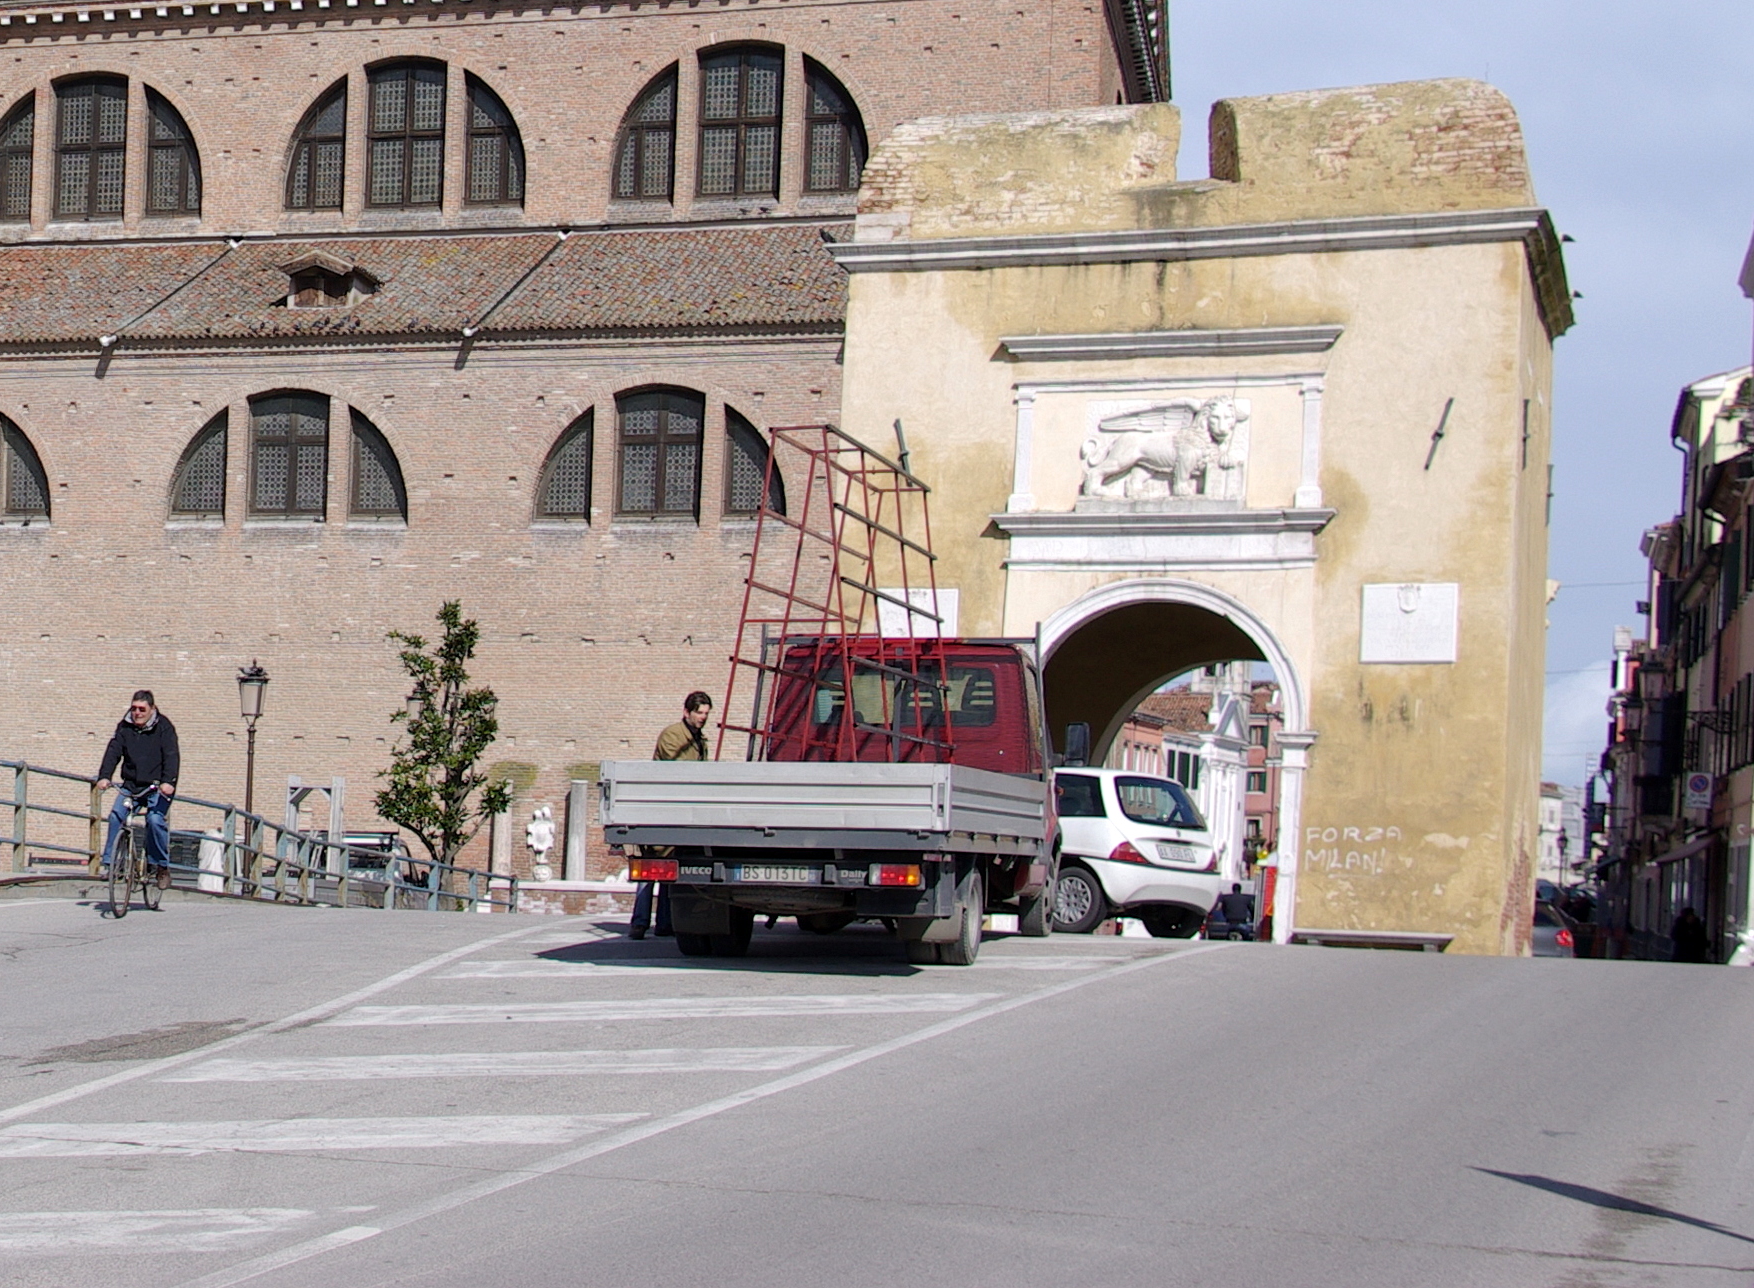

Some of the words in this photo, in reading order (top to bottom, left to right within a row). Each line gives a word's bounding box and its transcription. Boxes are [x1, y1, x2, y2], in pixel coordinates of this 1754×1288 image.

[1306, 825, 1402, 844] FORZA
[1304, 847, 1386, 875] MILAN!
[680, 866, 713, 875] IVECO
[743, 866, 759, 880] BS
[840, 868, 868, 879] Daily
